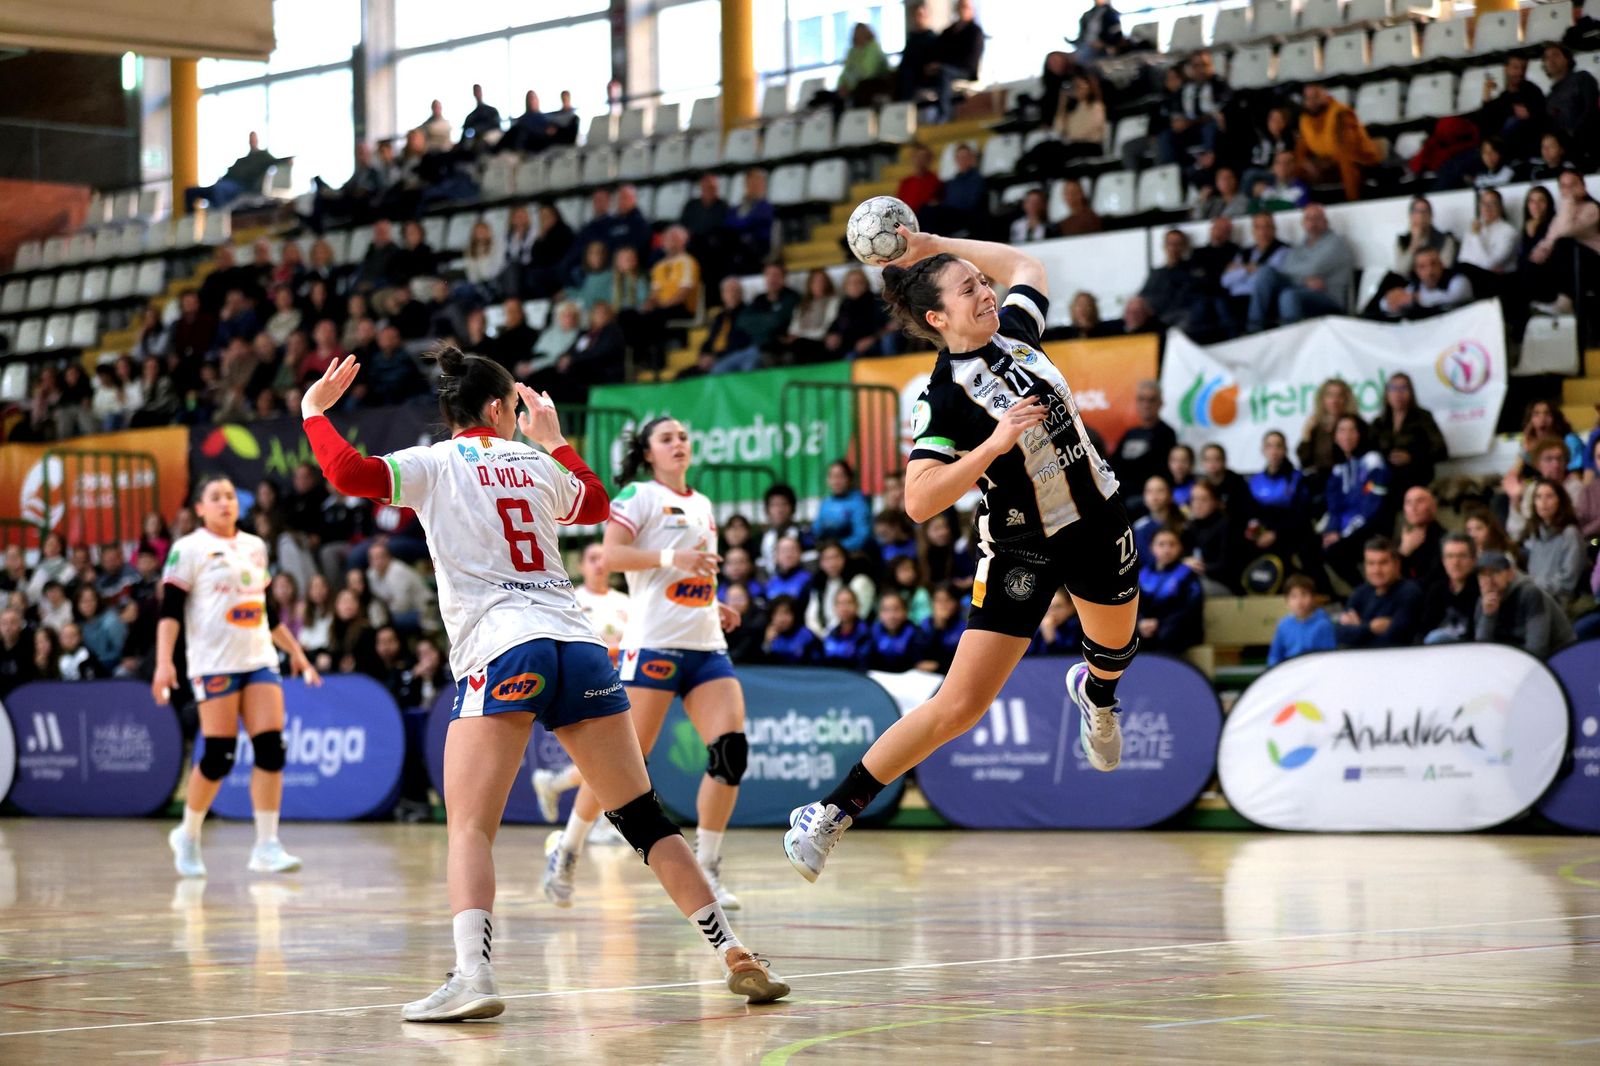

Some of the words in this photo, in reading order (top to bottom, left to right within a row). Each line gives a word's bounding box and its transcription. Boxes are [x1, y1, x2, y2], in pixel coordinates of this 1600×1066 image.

[1004, 362, 1034, 396] 27
[496, 498, 546, 572] 6
[1115, 525, 1134, 564] 27
[583, 682, 624, 699] Sagalés
[745, 708, 876, 745] undación
[743, 746, 836, 790] nicaja
